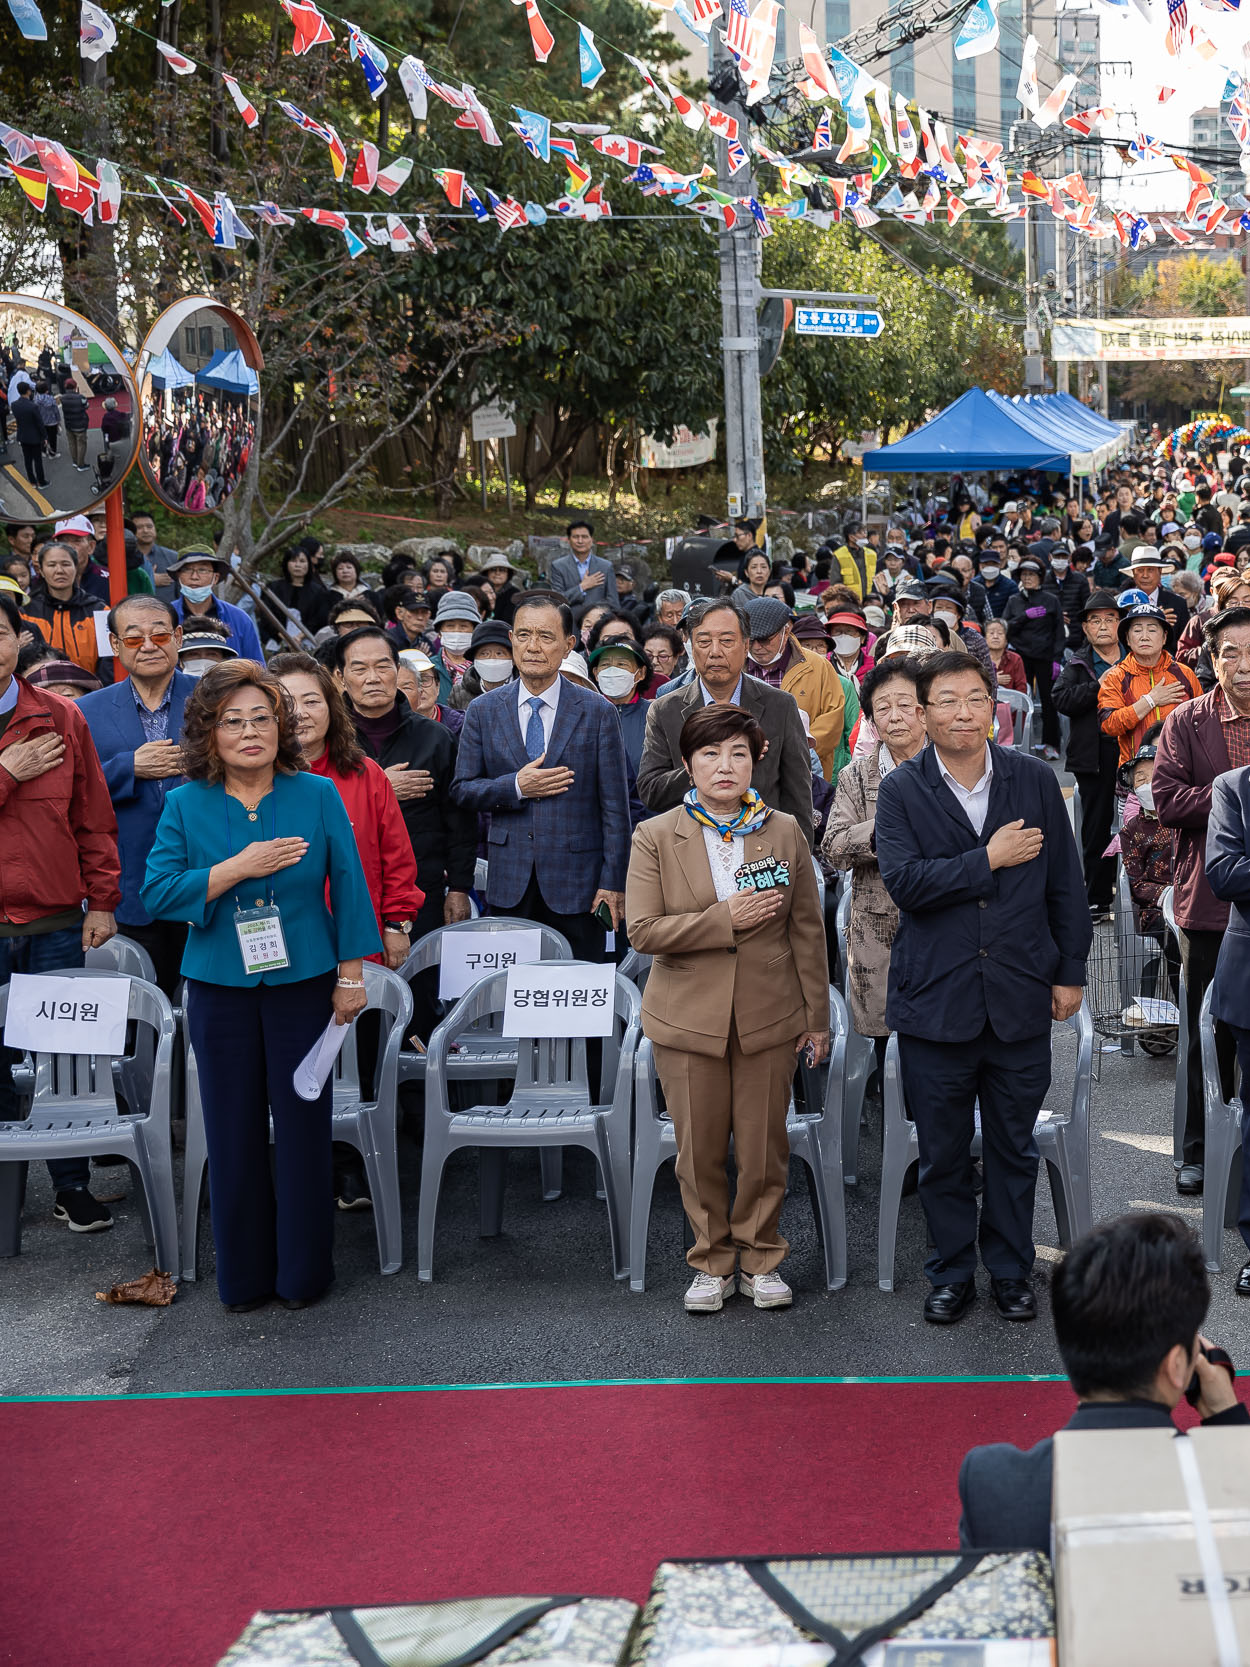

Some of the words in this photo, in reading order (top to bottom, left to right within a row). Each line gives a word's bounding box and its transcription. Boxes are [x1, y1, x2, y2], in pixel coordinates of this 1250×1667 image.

[742, 856, 776, 875] 국회의원
[465, 952, 517, 969] 구의원
[513, 988, 608, 1008] 당협위원장
[35, 1000, 99, 1022] 시의원
